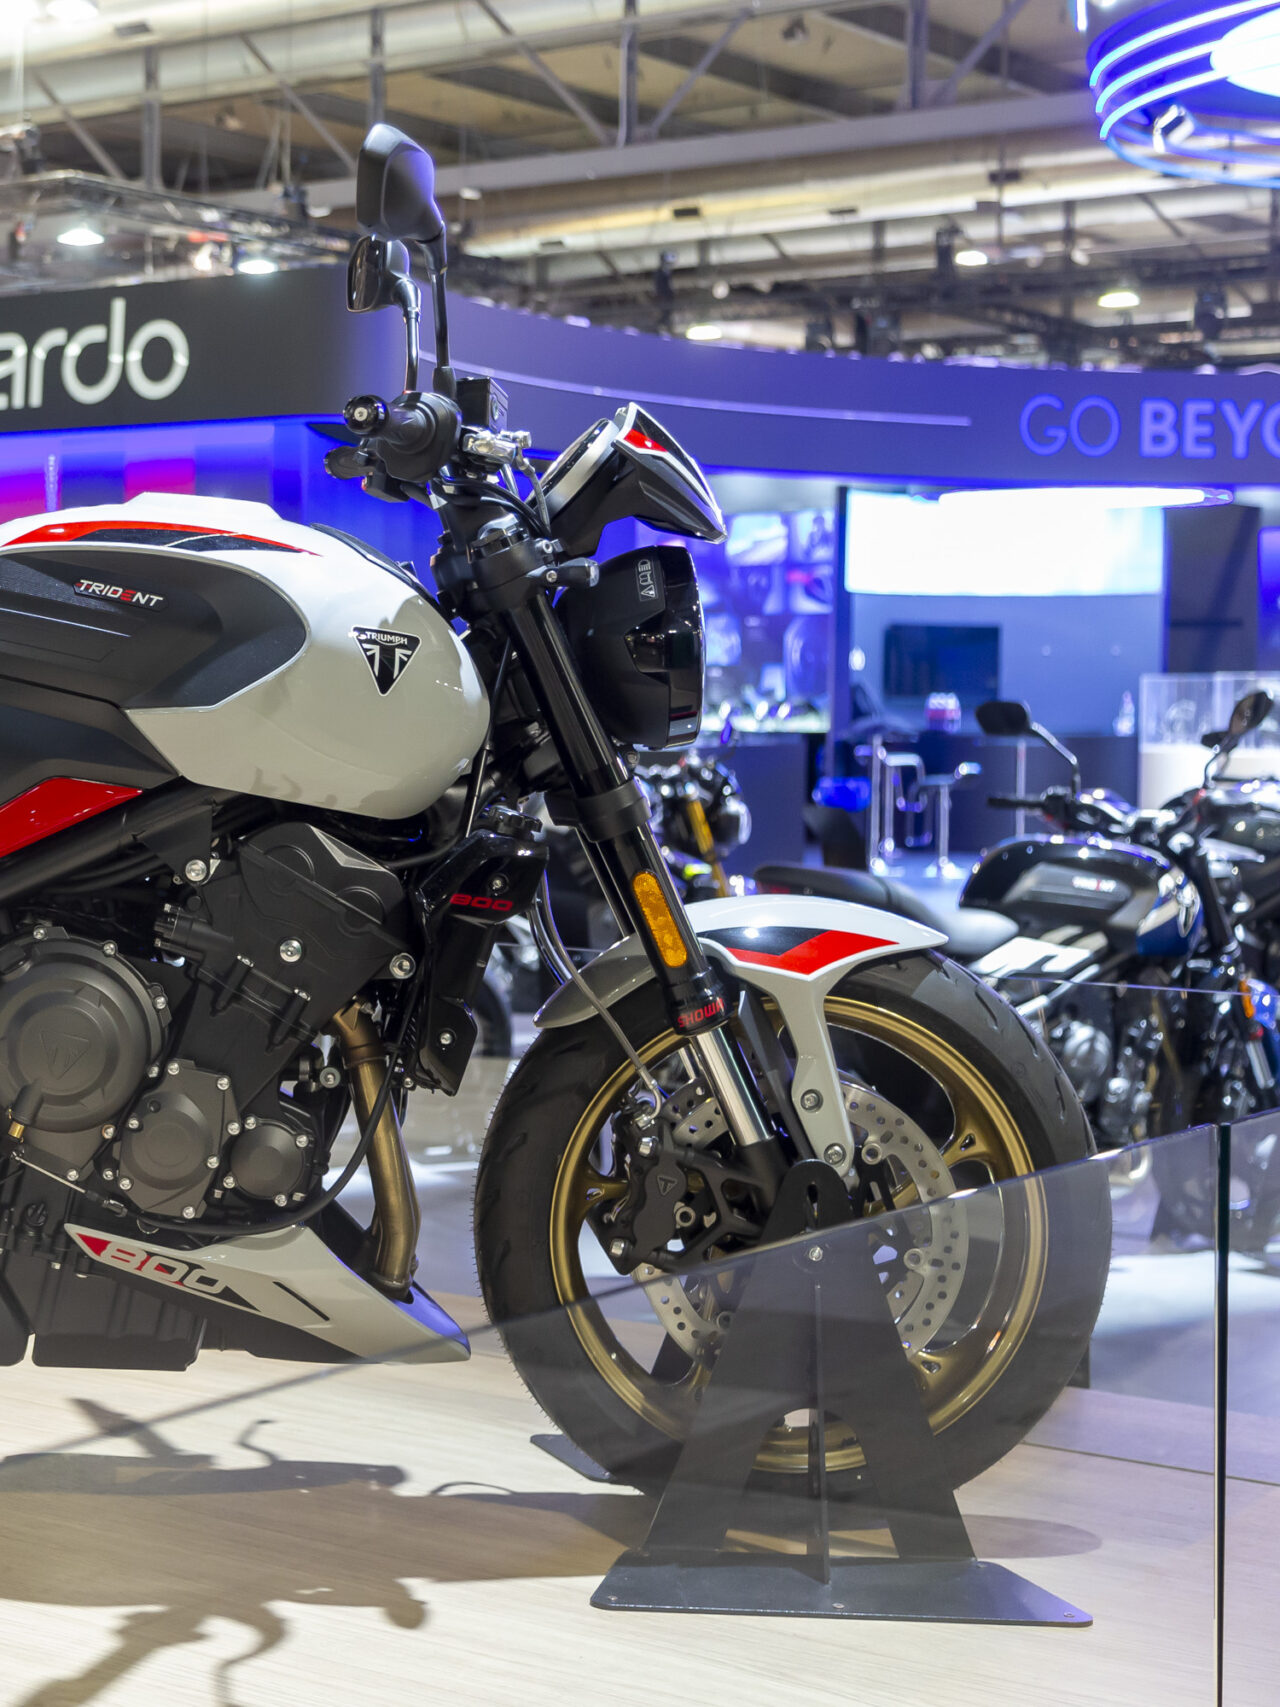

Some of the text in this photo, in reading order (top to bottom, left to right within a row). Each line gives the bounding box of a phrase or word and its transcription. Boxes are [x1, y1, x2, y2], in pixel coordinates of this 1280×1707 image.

[1020, 393, 1121, 457] GO
[79, 579, 164, 607] TRIDENT
[365, 631, 408, 645] TRIUMPH
[449, 893, 514, 912] 800
[677, 997, 724, 1028] SHOWA
[99, 1241, 227, 1294] 800
